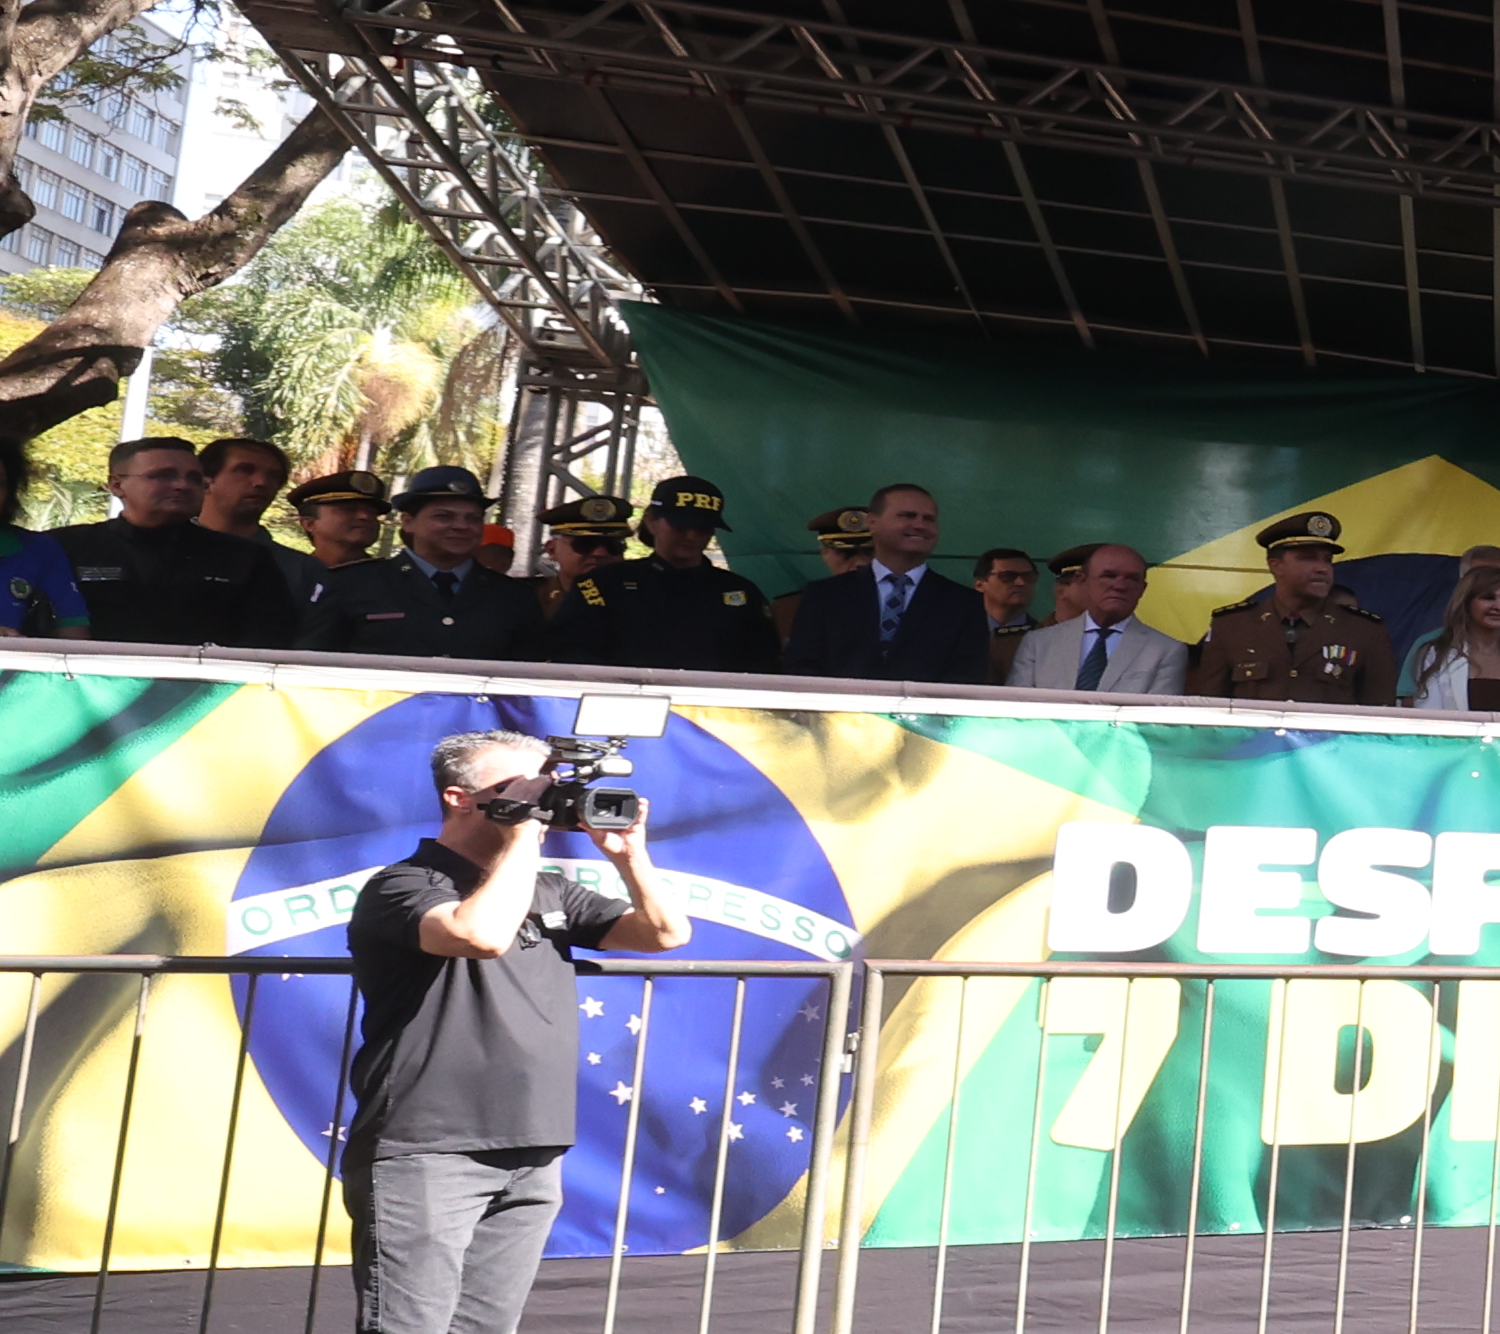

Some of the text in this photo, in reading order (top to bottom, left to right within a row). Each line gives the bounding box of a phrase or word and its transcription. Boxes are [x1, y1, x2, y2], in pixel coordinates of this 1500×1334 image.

[675, 491, 722, 512] PRF
[577, 577, 607, 607] PRF
[1036, 977, 1182, 1151] 7
